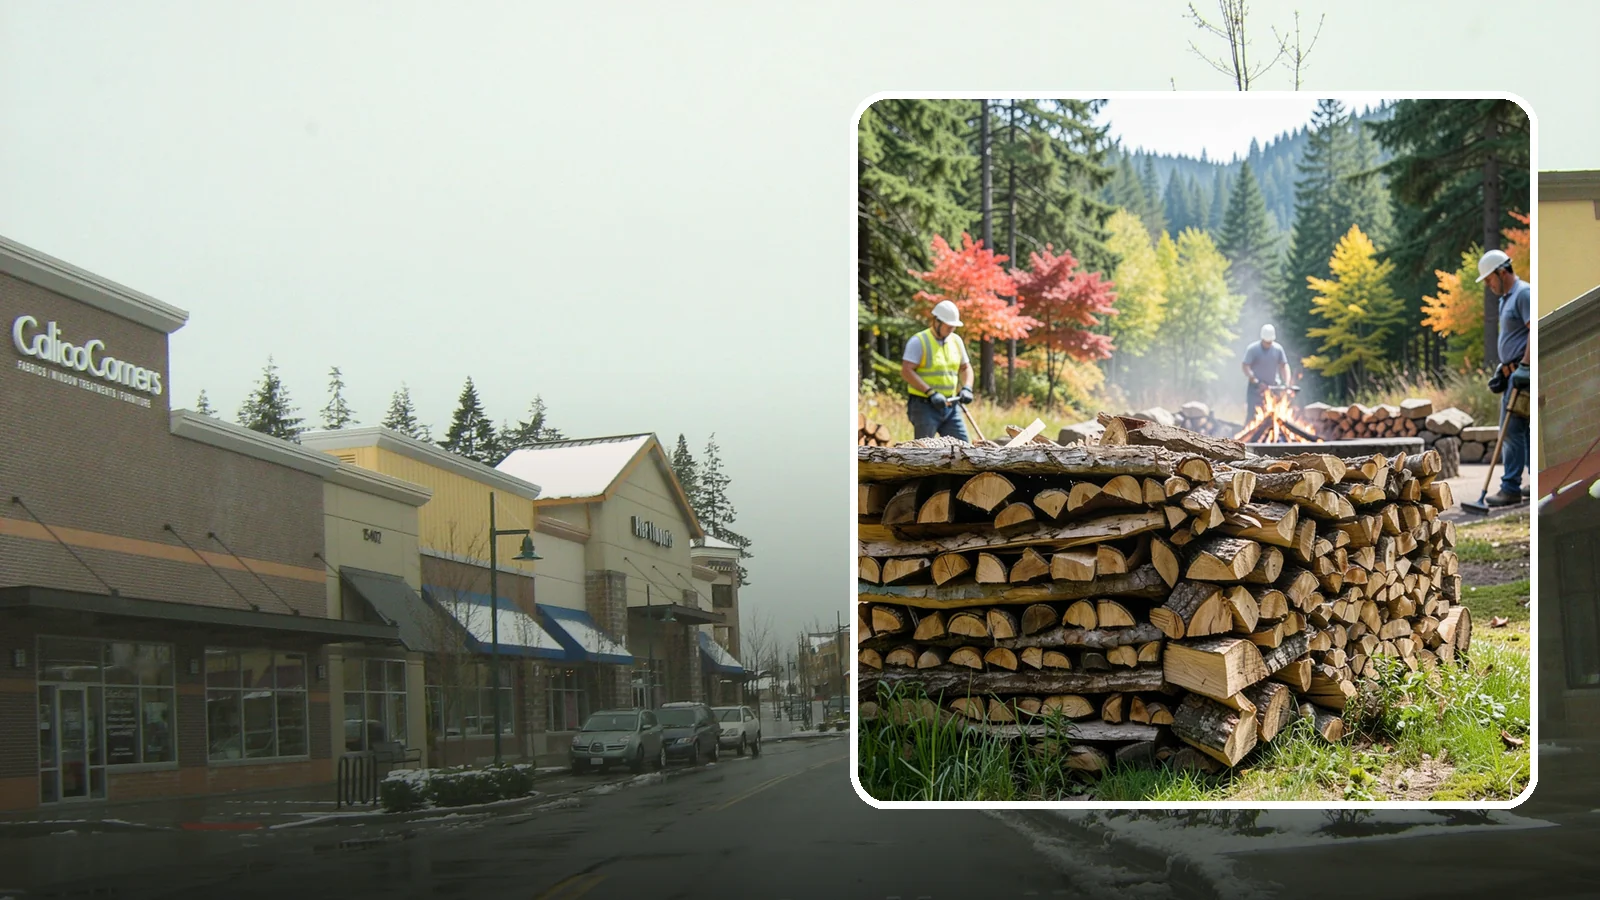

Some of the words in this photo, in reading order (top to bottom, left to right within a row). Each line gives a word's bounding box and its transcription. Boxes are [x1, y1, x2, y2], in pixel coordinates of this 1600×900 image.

[17, 360, 47, 377] FABRICS
[51, 371, 78, 386] WINDOW
[79, 379, 116, 398] TREATMENTS
